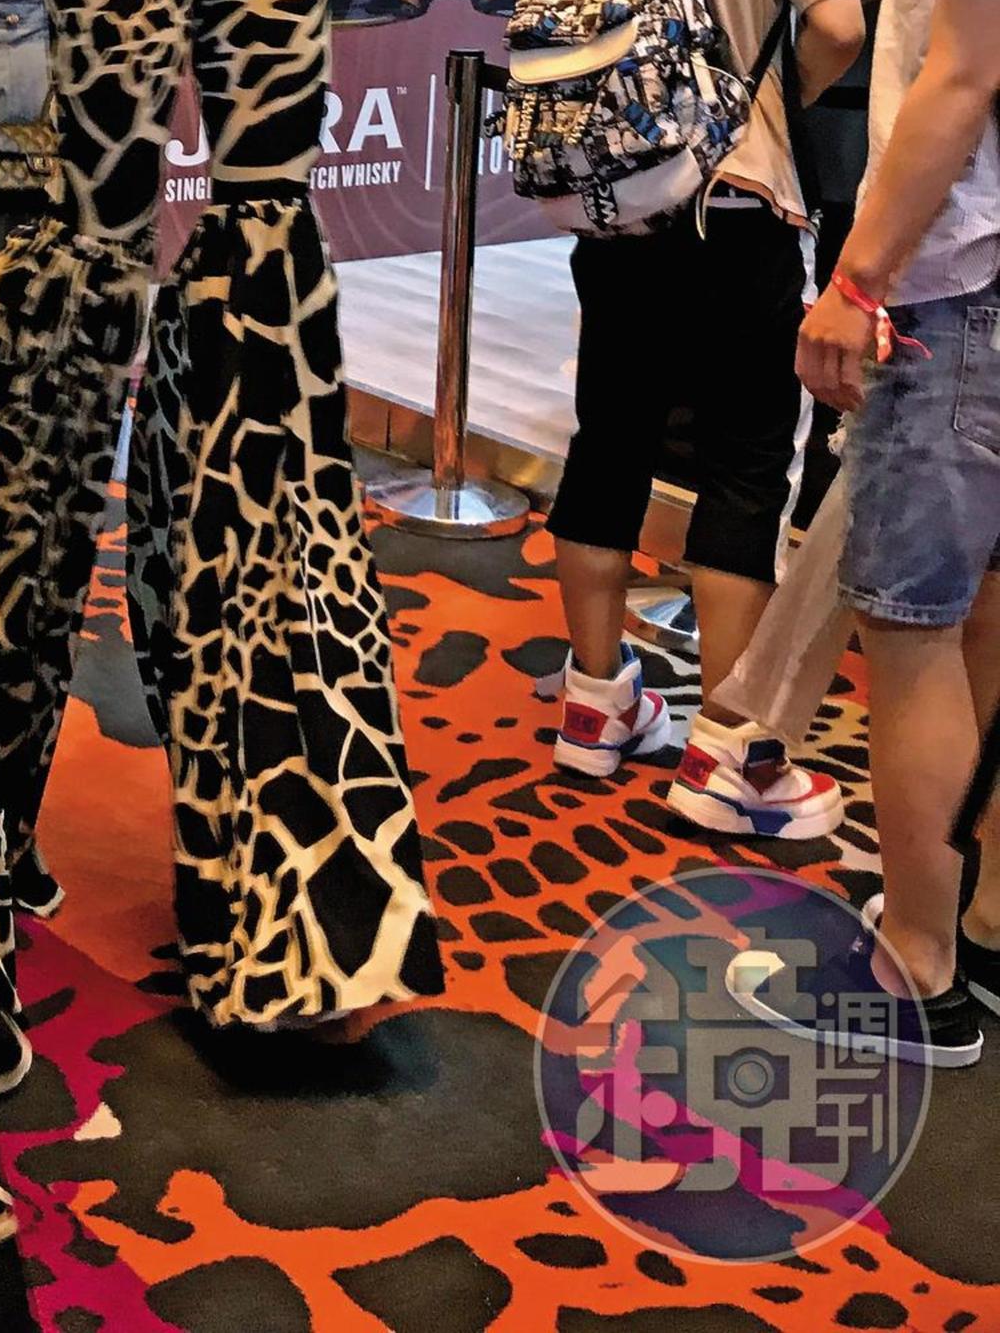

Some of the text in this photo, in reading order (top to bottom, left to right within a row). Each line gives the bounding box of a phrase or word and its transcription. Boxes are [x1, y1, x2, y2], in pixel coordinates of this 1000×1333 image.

[164, 87, 404, 166] JRA
[309, 165, 338, 190] TCH
[341, 160, 402, 187] WHISKY
